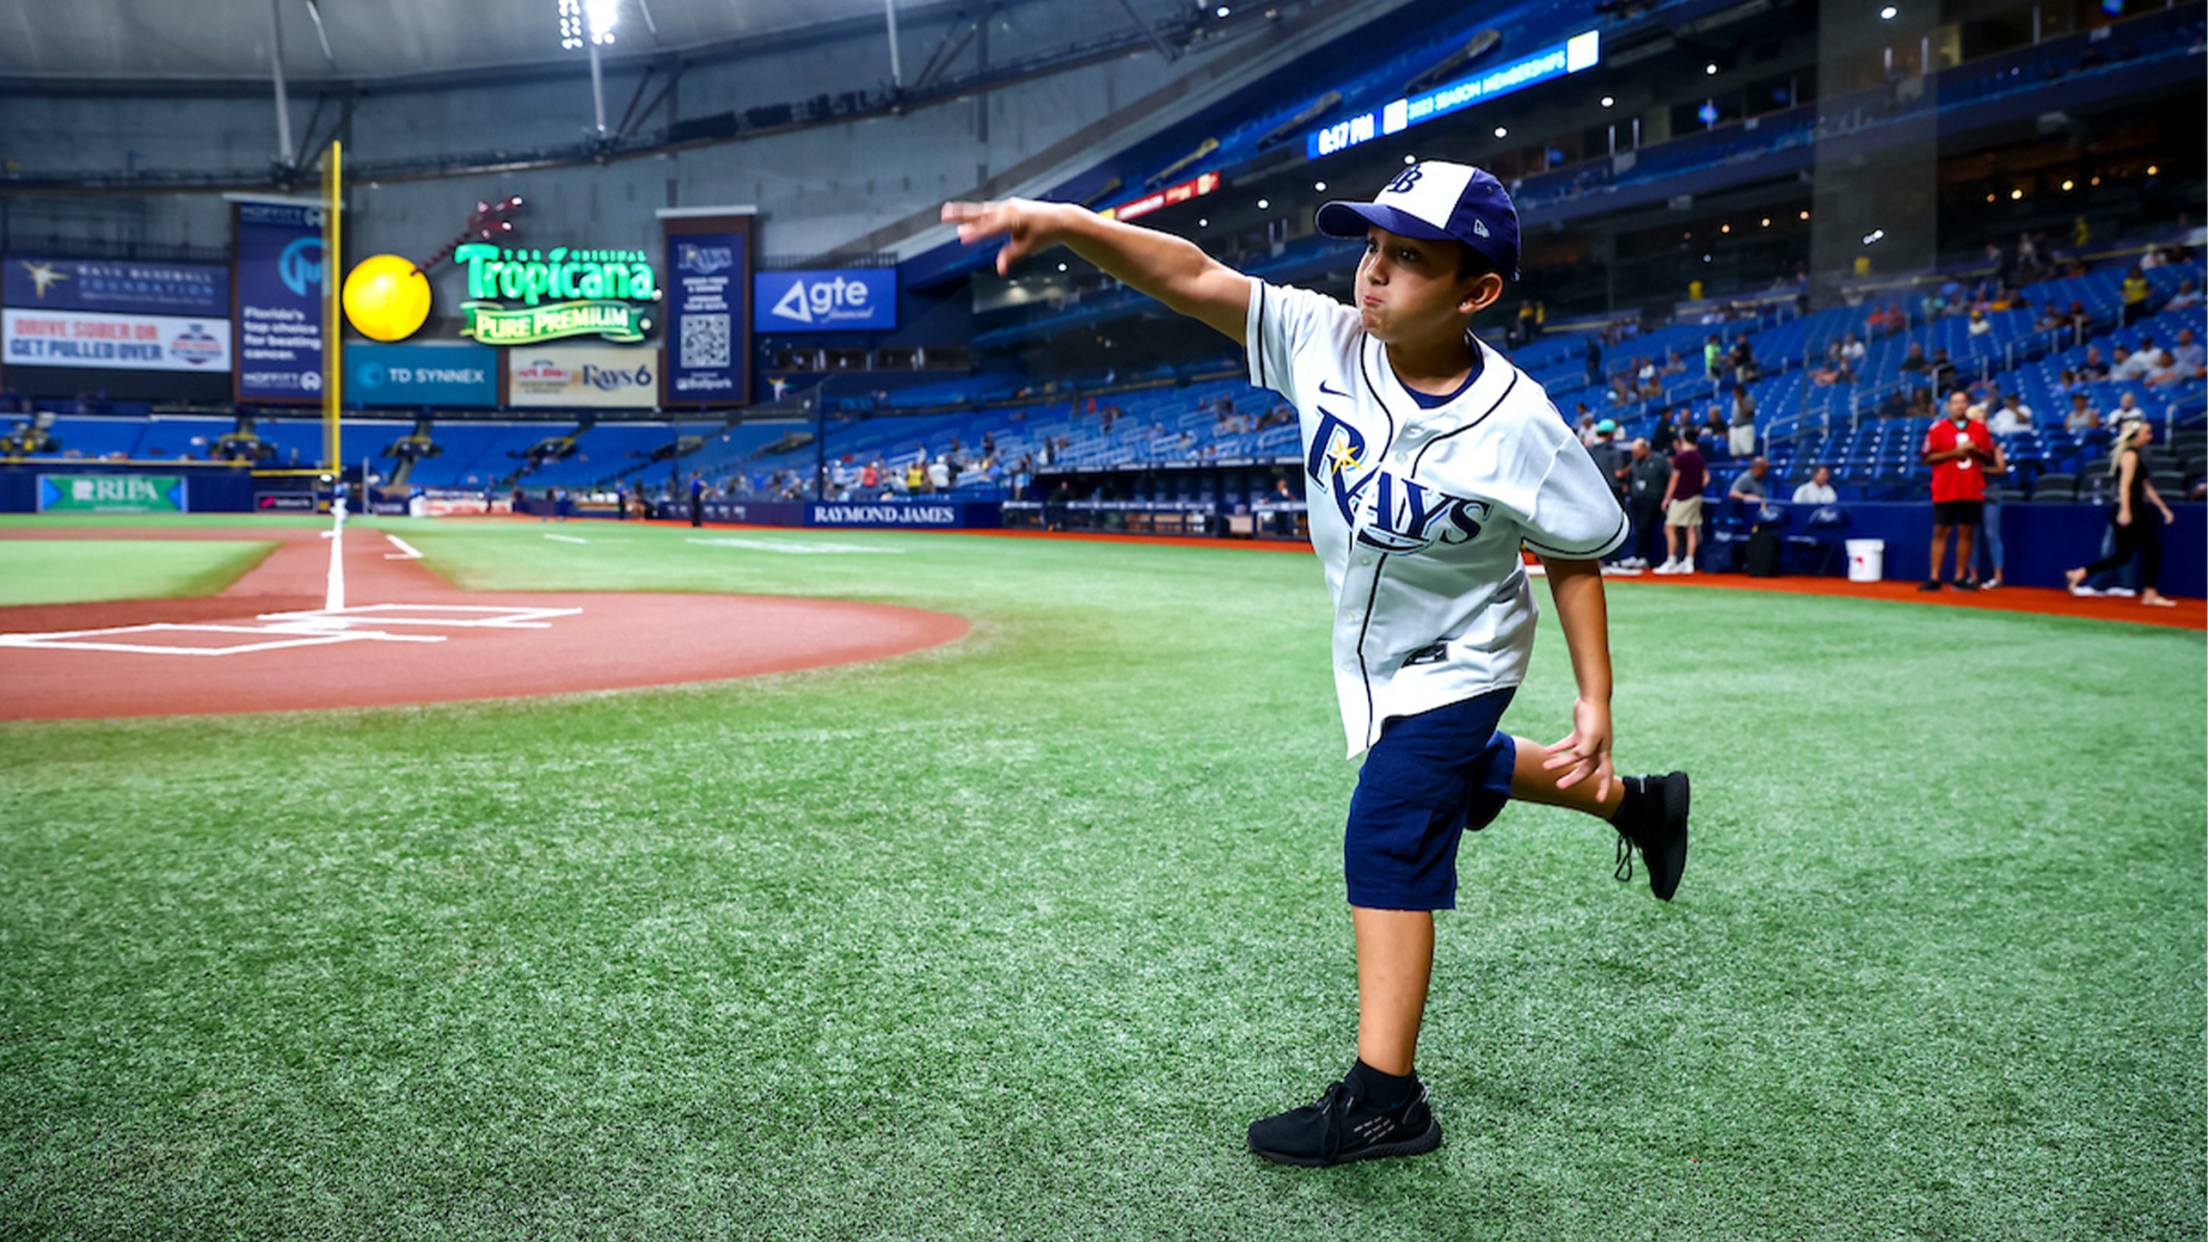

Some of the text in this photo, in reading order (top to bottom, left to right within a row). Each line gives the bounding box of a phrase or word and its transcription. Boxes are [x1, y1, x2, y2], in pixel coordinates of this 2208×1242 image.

[1434, 80, 1482, 111] SEASON
[1482, 50, 1566, 94] MEMBERSHIPS
[454, 242, 655, 306] Tropicana
[809, 276, 868, 315] gte
[243, 306, 305, 321] Florida's
[475, 306, 629, 339] PURE PREMIUM
[14, 318, 158, 341] DRIVE SOBER OR
[243, 321, 319, 336] top choice
[243, 333, 266, 346] for
[10, 338, 44, 356] GET
[48, 339, 115, 359] PULLED
[118, 342, 163, 361] OVER
[388, 367, 484, 384] TD SYNNEX
[635, 363, 653, 387] 6
[97, 480, 160, 501] RIPA
[814, 506, 955, 523] RAYMOND JAMES
